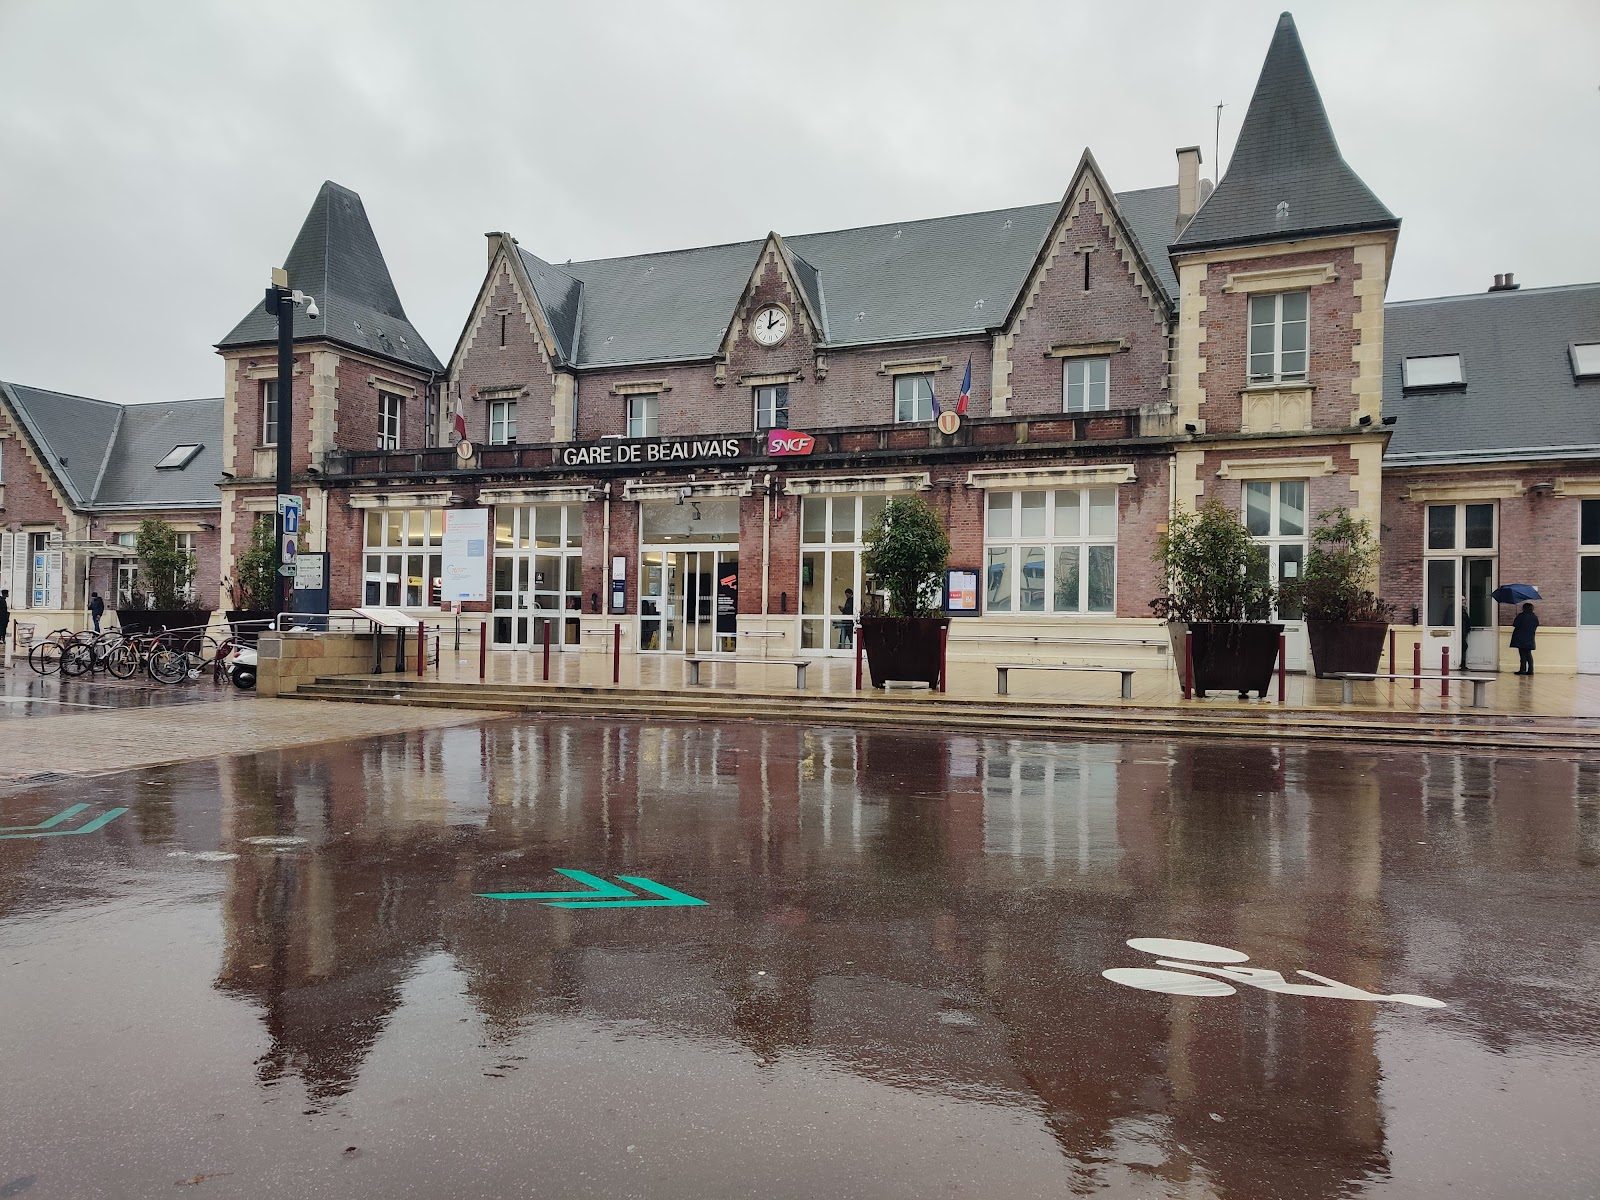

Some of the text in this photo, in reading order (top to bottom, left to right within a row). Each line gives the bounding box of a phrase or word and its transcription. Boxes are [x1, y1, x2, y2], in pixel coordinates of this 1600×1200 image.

[563, 439, 740, 465] GARE DE BEAUVAIS
[769, 438, 811, 452] SNCF
